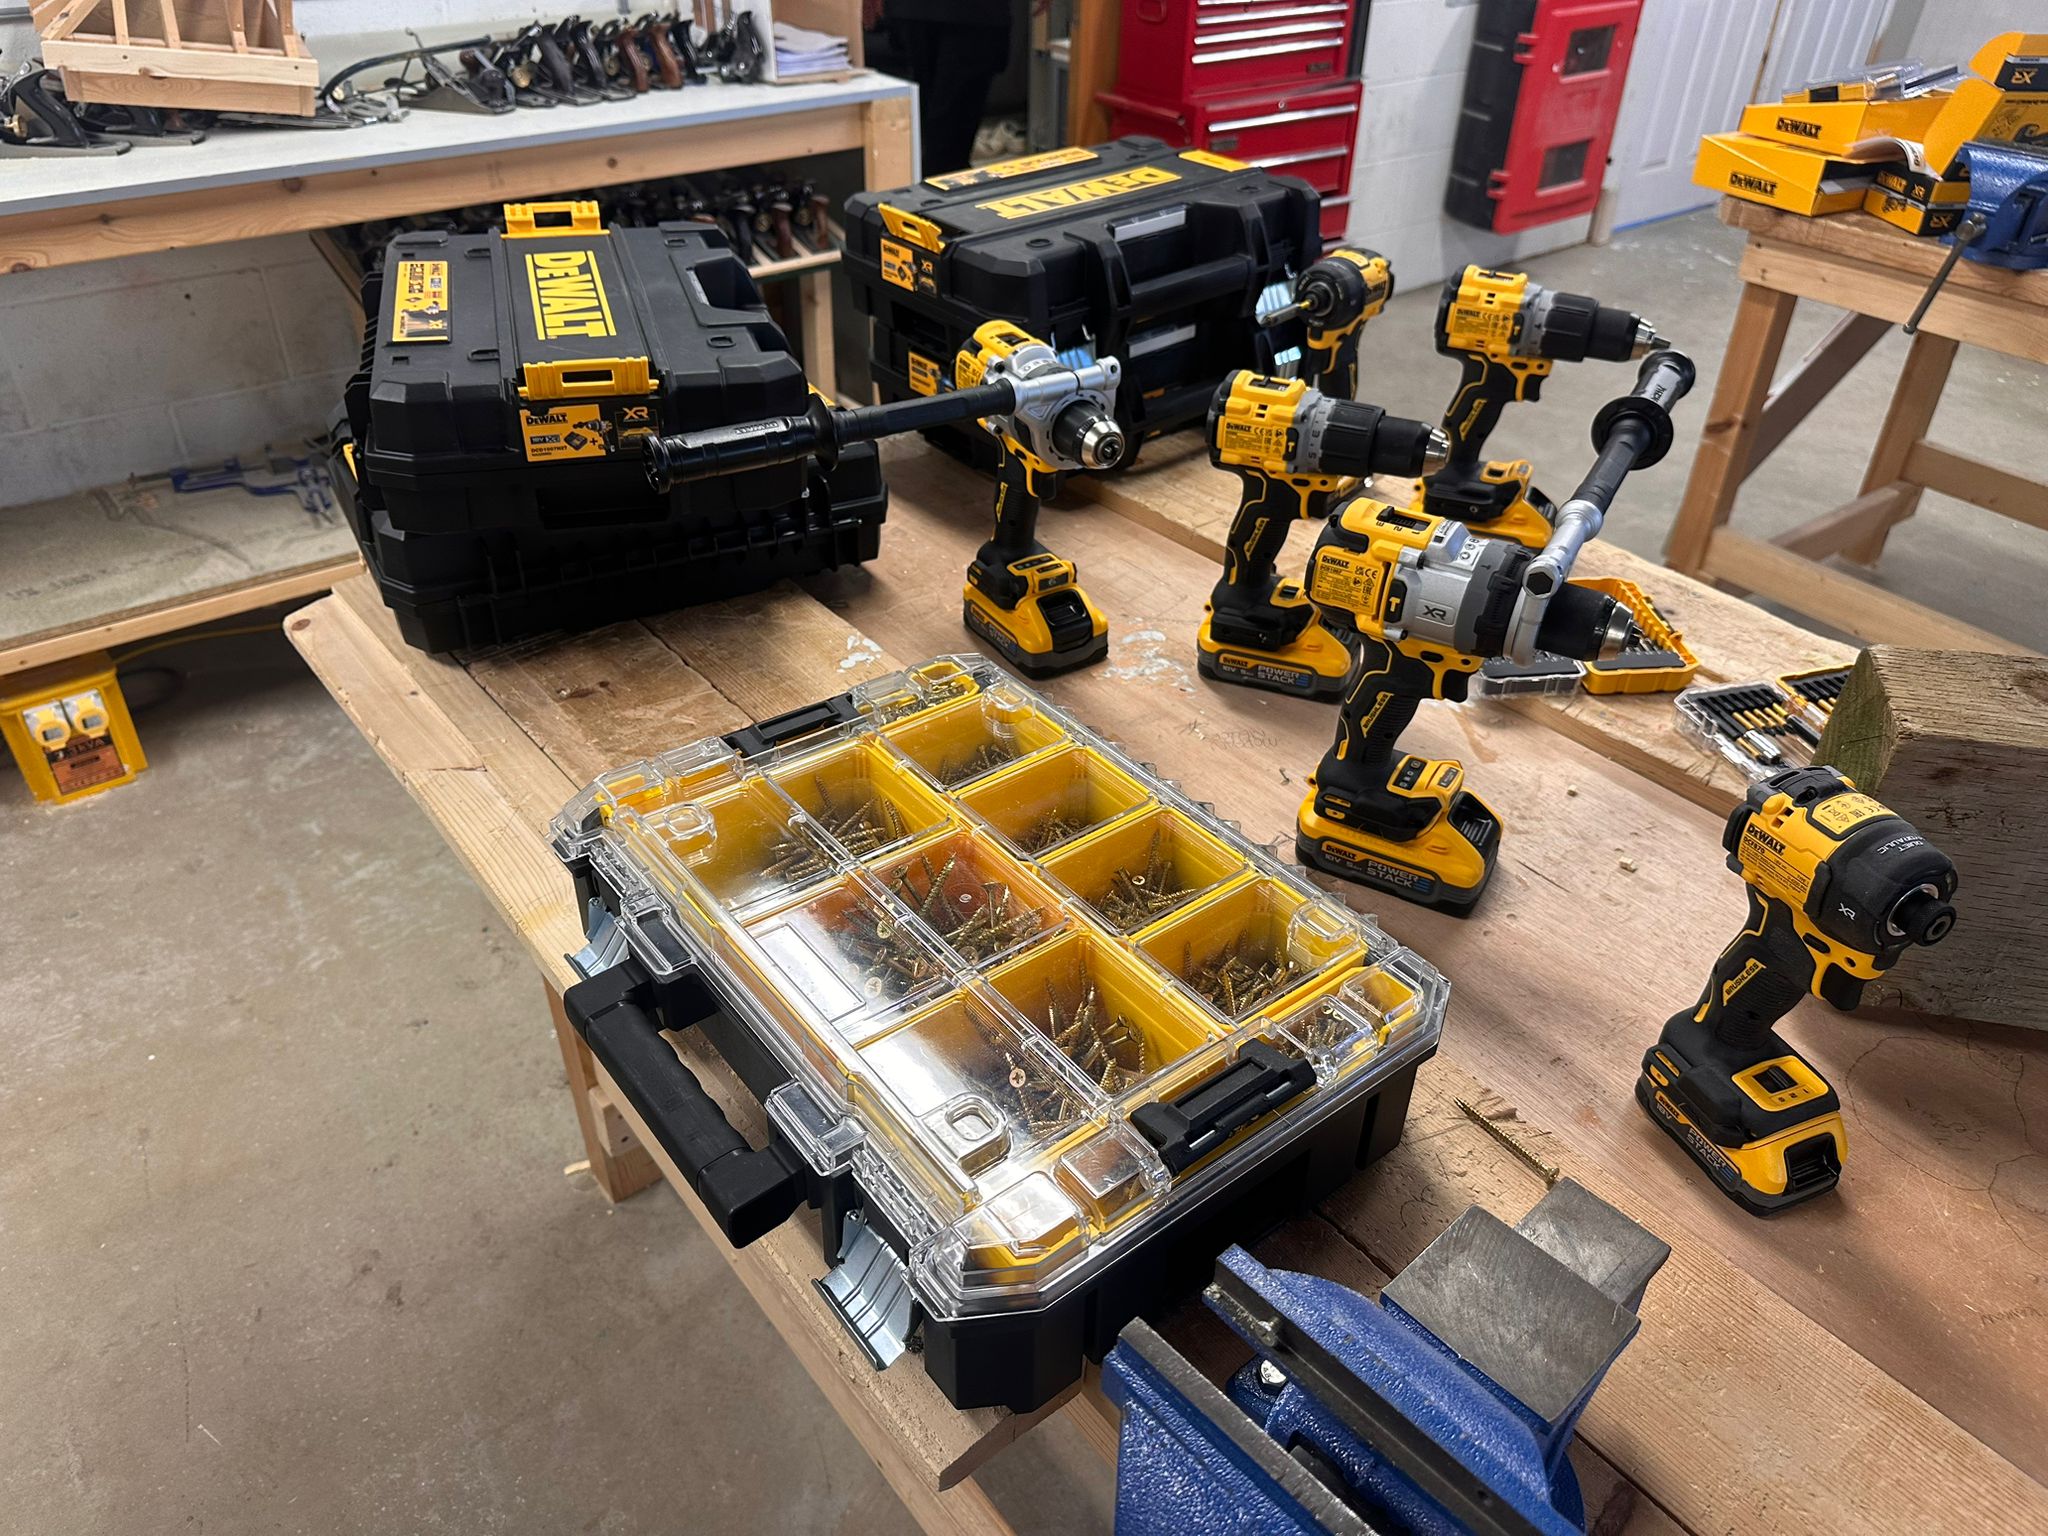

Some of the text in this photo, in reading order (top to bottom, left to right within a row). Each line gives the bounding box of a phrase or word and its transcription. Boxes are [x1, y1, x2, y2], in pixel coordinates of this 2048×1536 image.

[1776, 116, 1822, 139] DEWALT
[975, 166, 1182, 219] DEWALT
[1728, 171, 1777, 198] DEWALT
[528, 250, 613, 339] DEWALT
[526, 412, 569, 426] DEWALT
[623, 406, 649, 419] XR
[1226, 422, 1252, 433] DEWALT
[1322, 555, 1350, 569] DEWALT
[1423, 604, 1447, 620] XR
[1222, 656, 1249, 667] DEWALT
[1257, 672, 1295, 684] STACK
[1258, 665, 1299, 678] POWER
[1746, 823, 1787, 856] DEWALT
[1326, 844, 1357, 860] DEWALT
[1366, 868, 1413, 888] STACK
[1368, 861, 1418, 881] POWER
[1838, 902, 1856, 920] XR
[1725, 962, 1759, 995] BRUSHLESS
[1656, 1102, 1672, 1119] 18V
[1658, 1095, 1680, 1118] DEWALT
[1687, 1134, 1720, 1170] STACK
[1689, 1127, 1726, 1168] POWER
